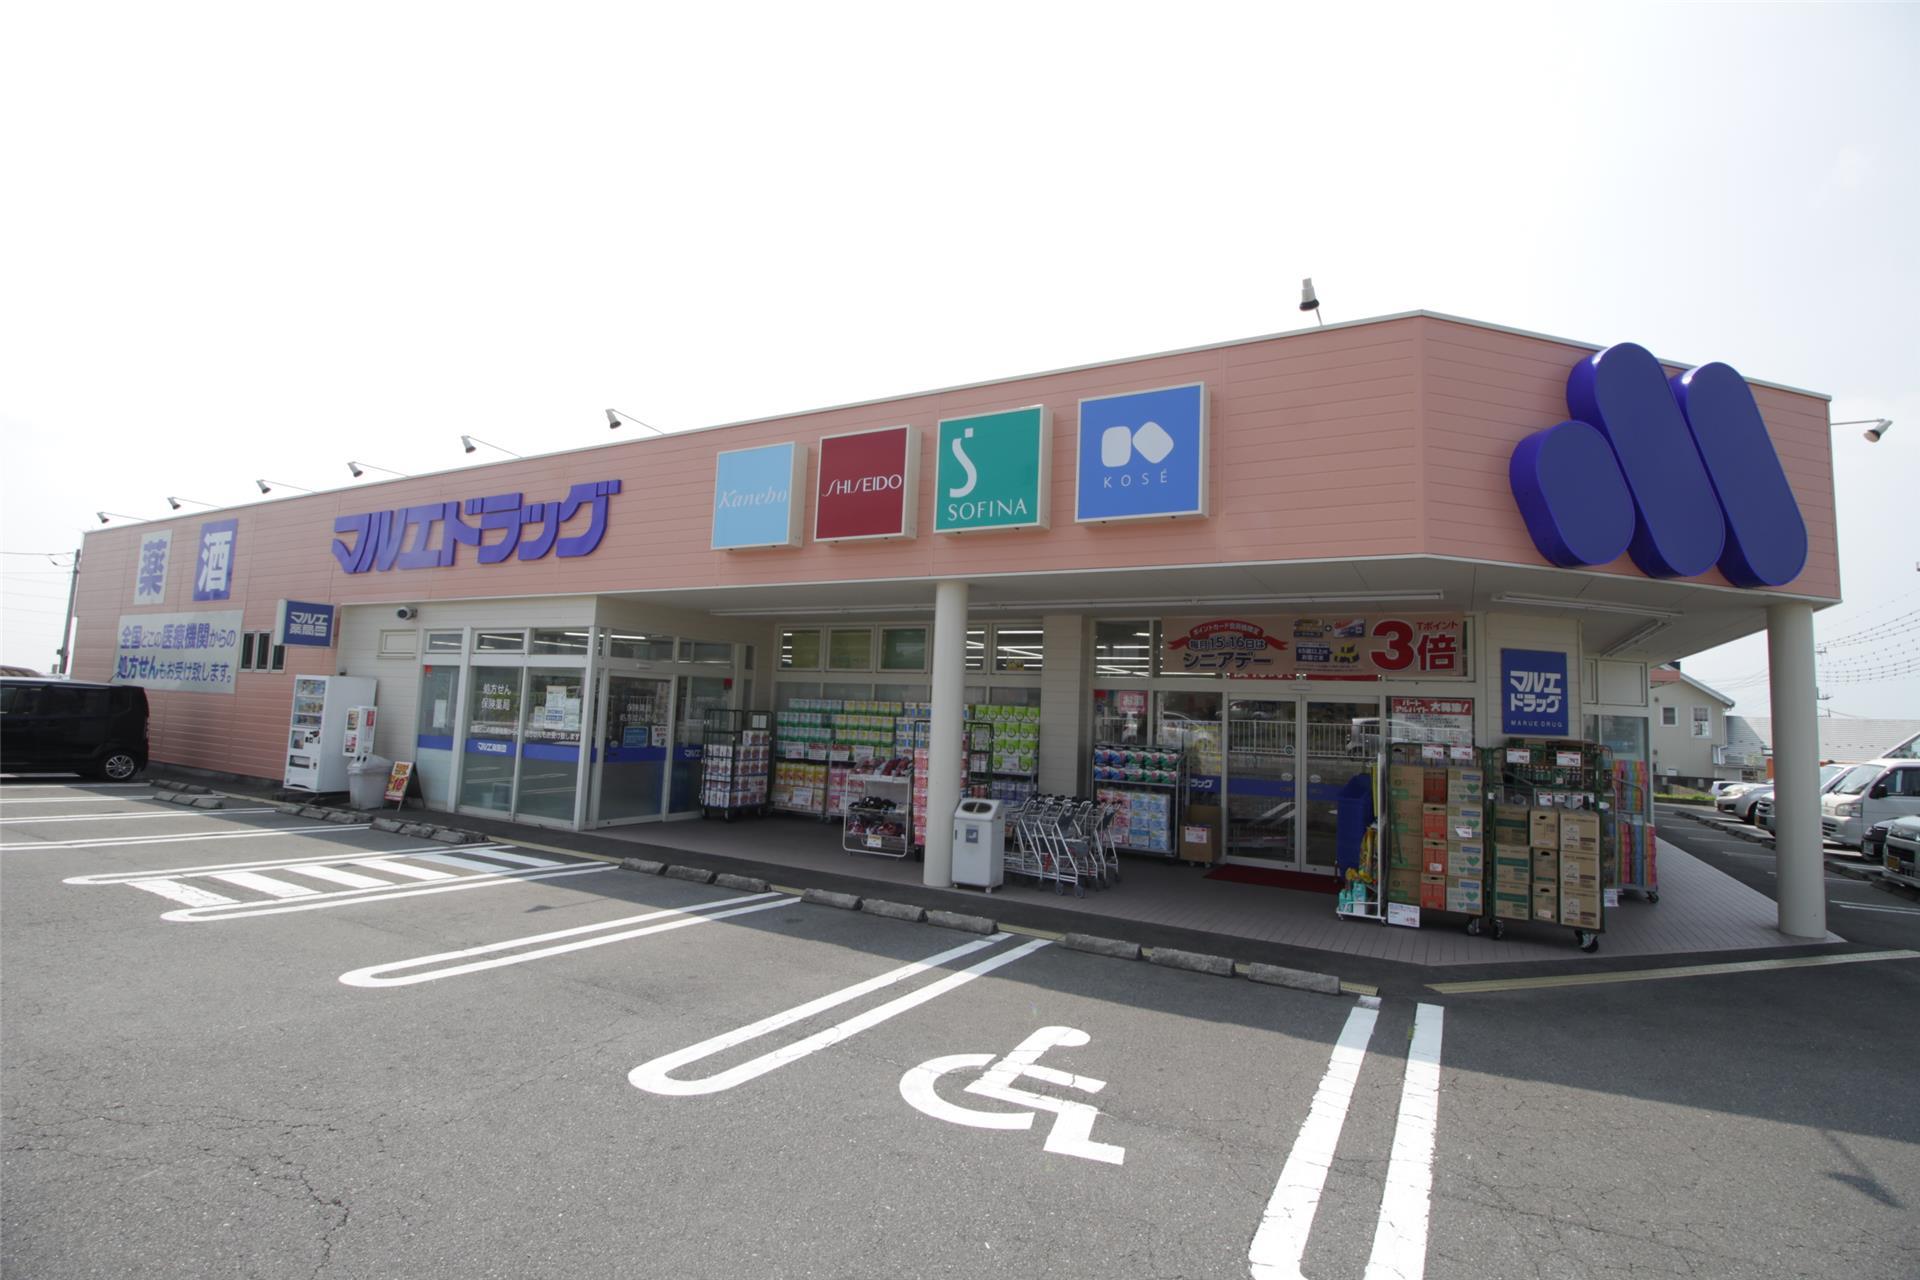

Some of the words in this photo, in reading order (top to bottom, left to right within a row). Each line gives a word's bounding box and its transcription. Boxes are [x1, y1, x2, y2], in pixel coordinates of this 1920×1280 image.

[821, 473, 903, 497] SHISEIDO
[1103, 468, 1168, 489] KOSÉ
[718, 486, 787, 509] Kanebo
[948, 497, 1028, 521] SOFINA
[332, 479, 622, 574] マルエドラッグ
[138, 538, 168, 596] 薬
[197, 530, 233, 593] 酒
[289, 611, 329, 626] マルエ
[1416, 619, 1459, 631] Tポイント
[120, 622, 236, 650] 全国どこの医療機関からの
[1183, 650, 1272, 670] シニアデー
[482, 683, 512, 695] 処方せん
[1510, 670, 1562, 694] マルエ
[1510, 693, 1562, 714] ドラッグ
